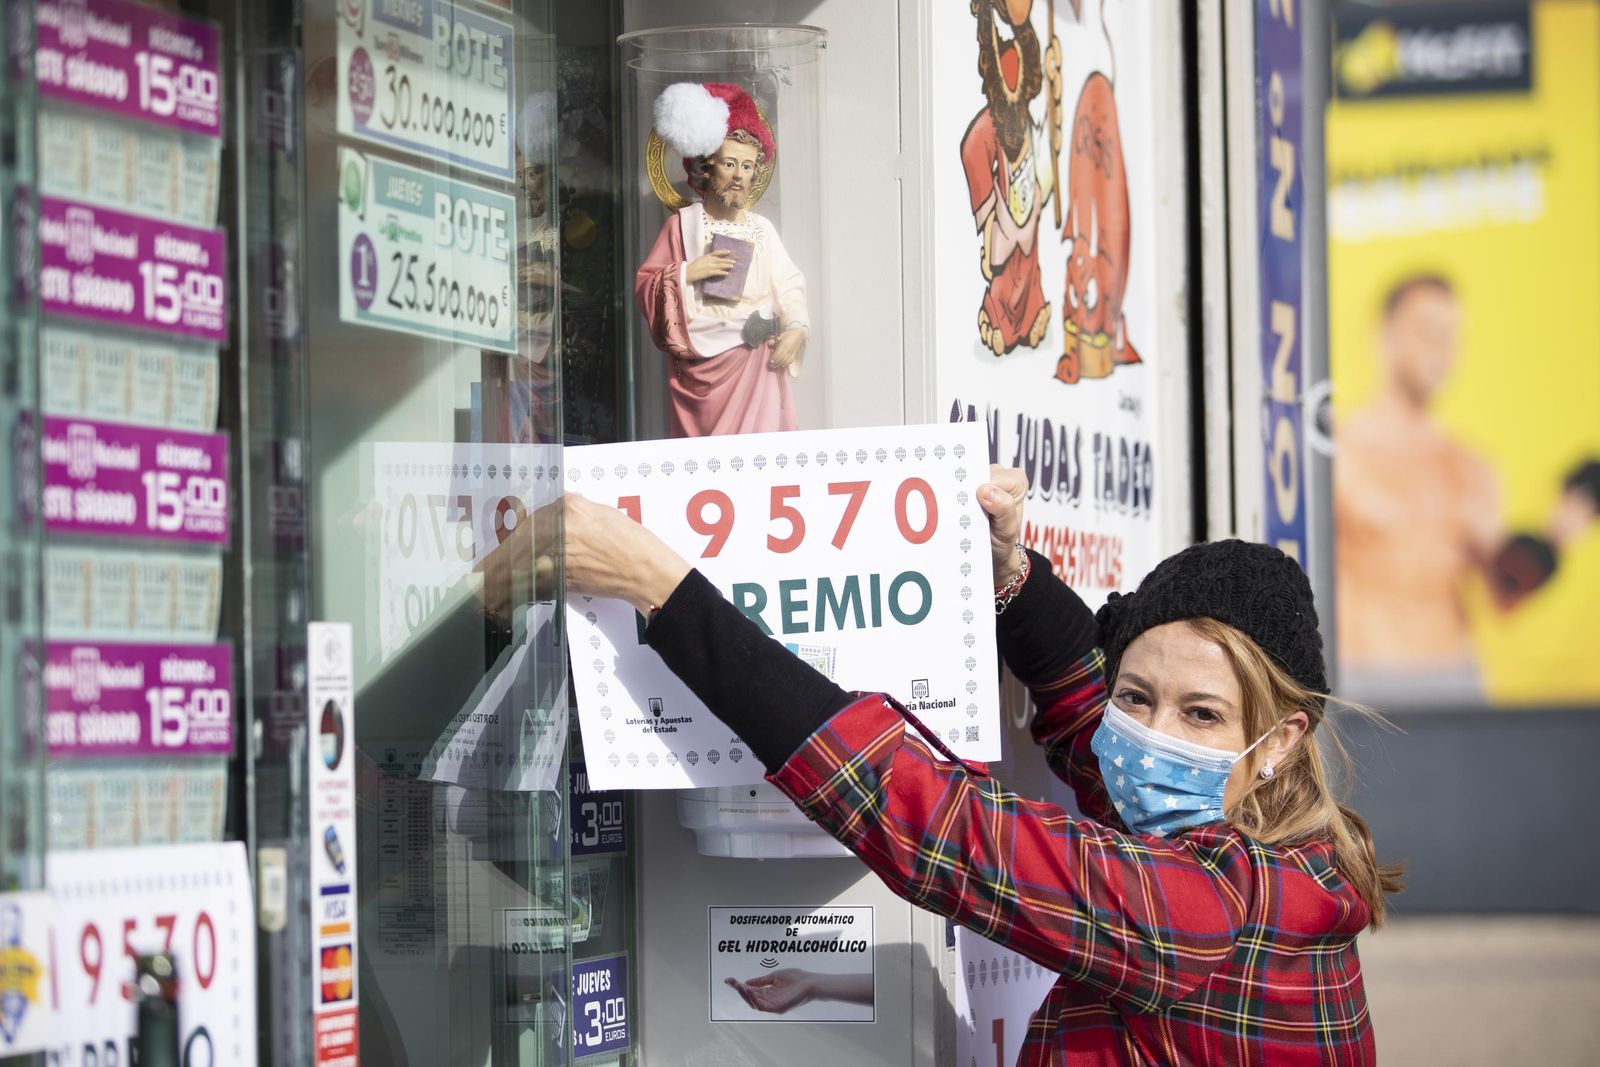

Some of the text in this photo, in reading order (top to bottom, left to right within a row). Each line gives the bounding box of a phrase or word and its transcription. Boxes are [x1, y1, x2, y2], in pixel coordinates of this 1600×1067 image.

[433, 14, 508, 90] BOTE
[381, 65, 495, 148] 30.000.000
[434, 192, 509, 262] BOTE
[387, 252, 498, 328] 25.500.000
[1012, 412, 1082, 507] JUDAS
[732, 570, 934, 636] REMIO
[919, 698, 956, 710] Nacional
[654, 718, 659, 726] y
[660, 716, 693, 726] Apuestas
[654, 726, 678, 734] Estado
[582, 802, 622, 846] 3,00
[602, 833, 623, 844] EUROS
[730, 913, 854, 925] DOSIFICADOR AUTOMÁTICO
[786, 927, 799, 937] DE
[718, 937, 867, 954] GEL HIDROALCOHÓLICO
[577, 968, 611, 997] JUEVES
[584, 997, 626, 1047] 3,00
[605, 1029, 626, 1042] EUROS
